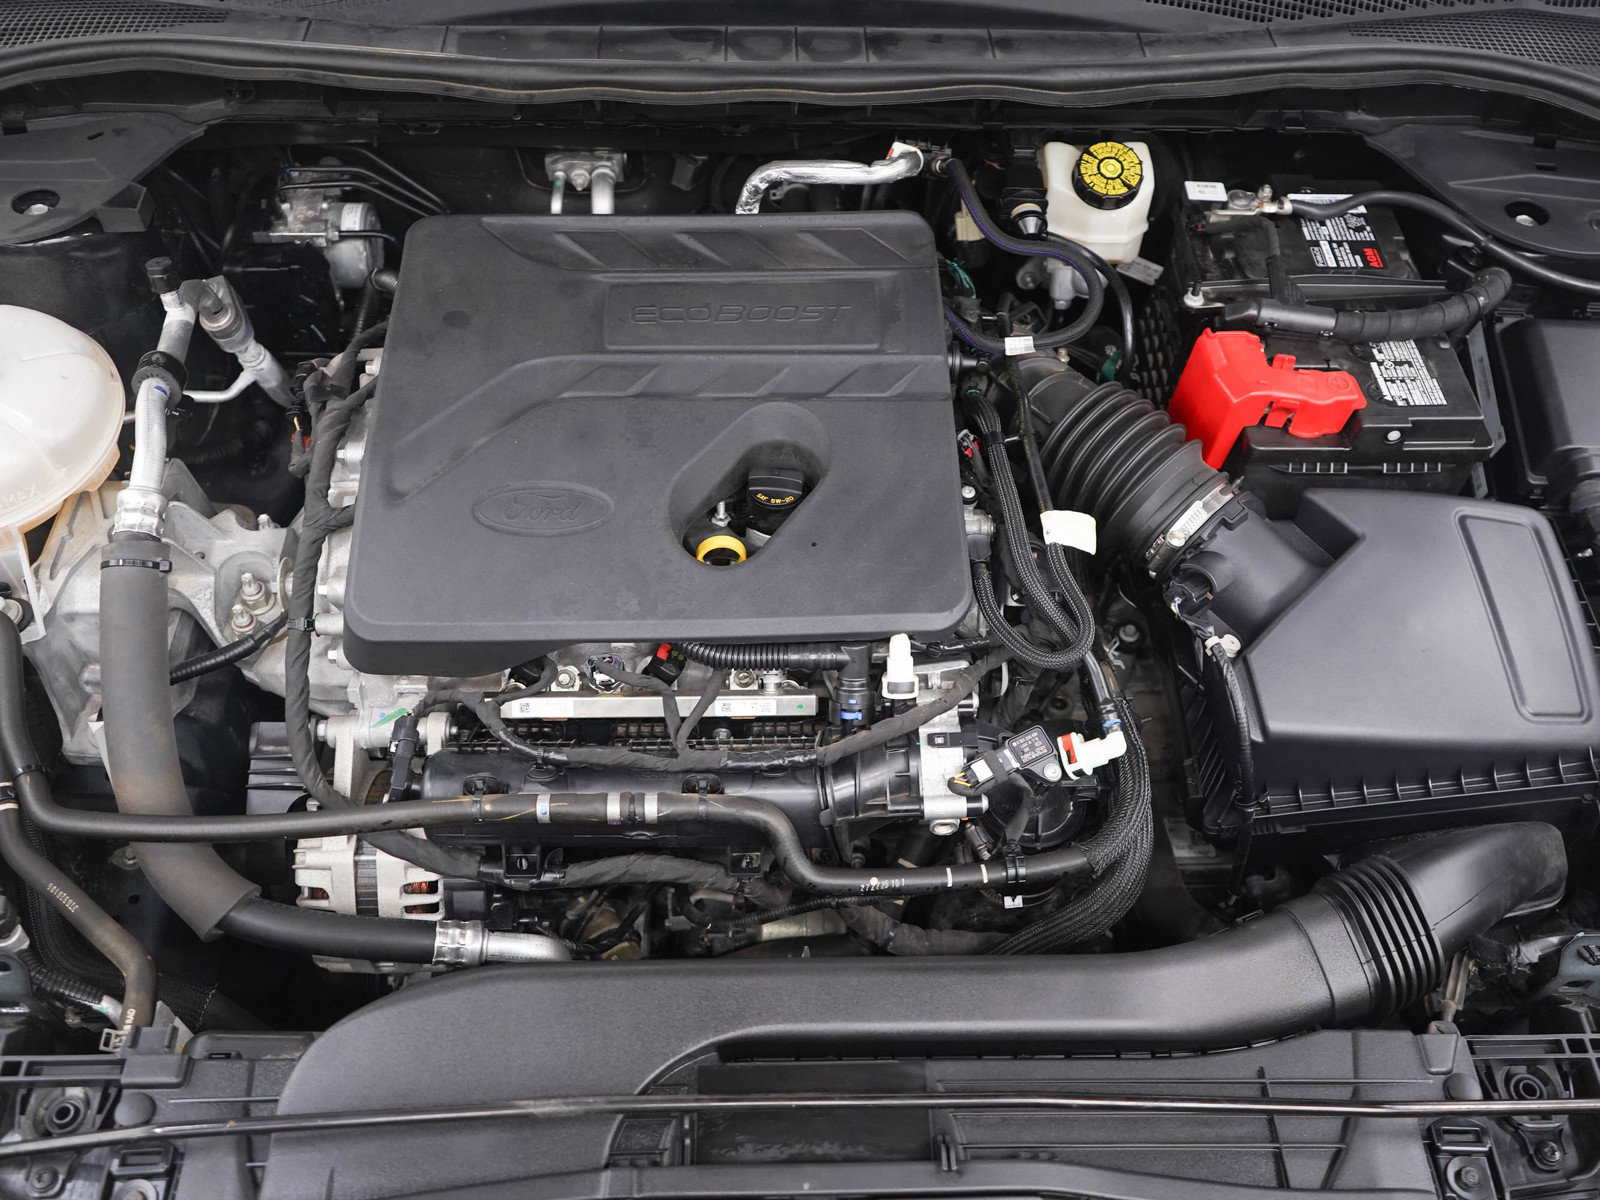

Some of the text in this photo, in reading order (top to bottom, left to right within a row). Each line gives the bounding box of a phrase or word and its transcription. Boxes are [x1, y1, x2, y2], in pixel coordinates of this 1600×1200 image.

[1363, 248, 1380, 268] AGM
[631, 304, 852, 324] ECOBOOST
[503, 492, 584, 523] Ford
